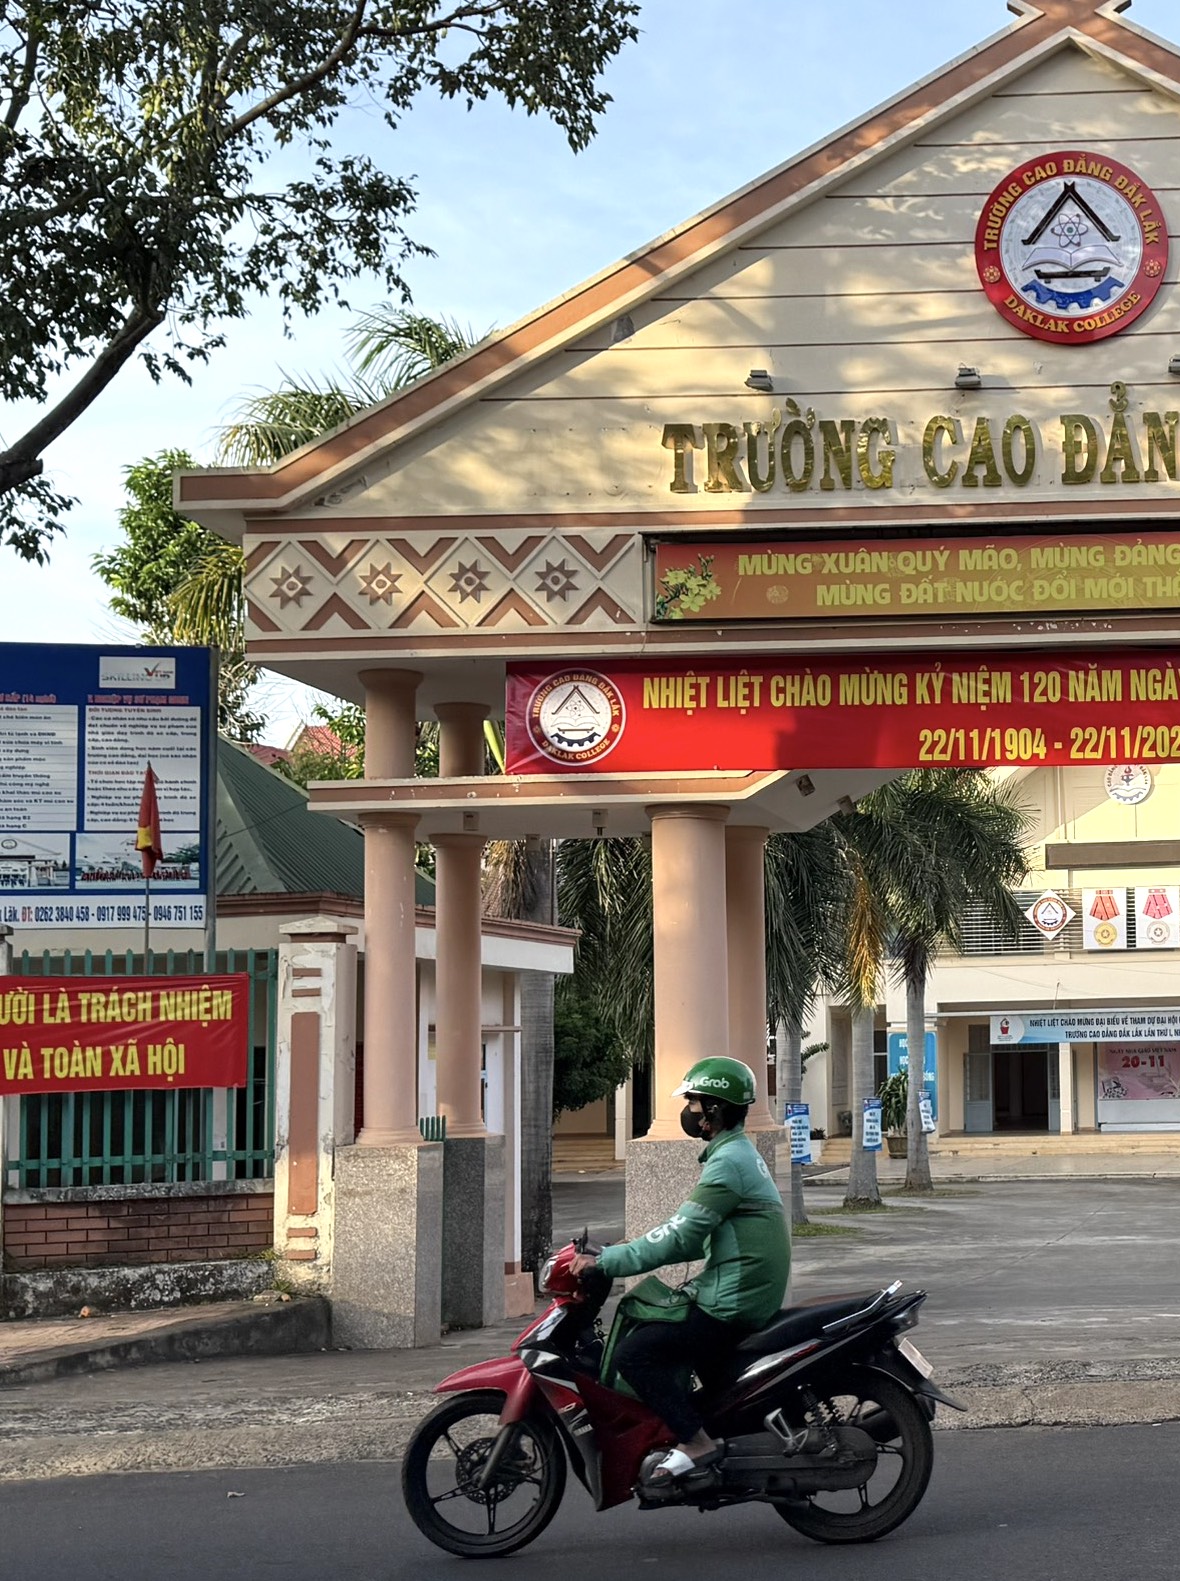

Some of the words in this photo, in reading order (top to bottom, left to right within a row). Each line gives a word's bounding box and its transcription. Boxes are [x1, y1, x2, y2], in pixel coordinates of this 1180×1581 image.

[984, 182, 1023, 250] TRƯỜNG
[1022, 161, 1057, 186] CAO
[1004, 294, 1069, 333] DAKLAK
[1073, 290, 1141, 333] COLLEGE
[662, 397, 896, 493] TRƯỜNG
[922, 414, 1036, 488] CAO
[738, 548, 813, 576] MỪNG
[822, 547, 889, 574] XUÂN
[898, 545, 950, 573] QUÝ
[958, 544, 1022, 573] MÃO,
[1031, 541, 1104, 568] MỪNG
[816, 580, 891, 607] MỪNG
[899, 574, 950, 604] ĐẤT
[956, 576, 1024, 603] NƯỚC
[1032, 569, 1077, 601] ĐỔI
[1084, 574, 1134, 600] MỚI
[642, 670, 710, 716] NHIỆT
[716, 668, 764, 715] LIỆT
[770, 667, 831, 707] CHÀO
[839, 666, 909, 706] MỪNG
[915, 661, 944, 705] KỶ
[951, 665, 1012, 711] NIỆM
[1019, 671, 1061, 703] 120
[1068, 662, 1122, 702] NĂM
[918, 728, 1047, 761] 22/11/1904
[42, 987, 71, 1024] LÀ
[78, 986, 152, 1023] TRÁCH
[159, 984, 232, 1027] NHIỆM
[3, 1040, 34, 1080] VÀ
[40, 1039, 102, 1079] TOÀN
[109, 1038, 140, 1077] XÃ
[147, 1037, 185, 1082] HỘI
[1122, 1055, 1165, 1068] 20-11
[702, 1076, 730, 1089] Grab
